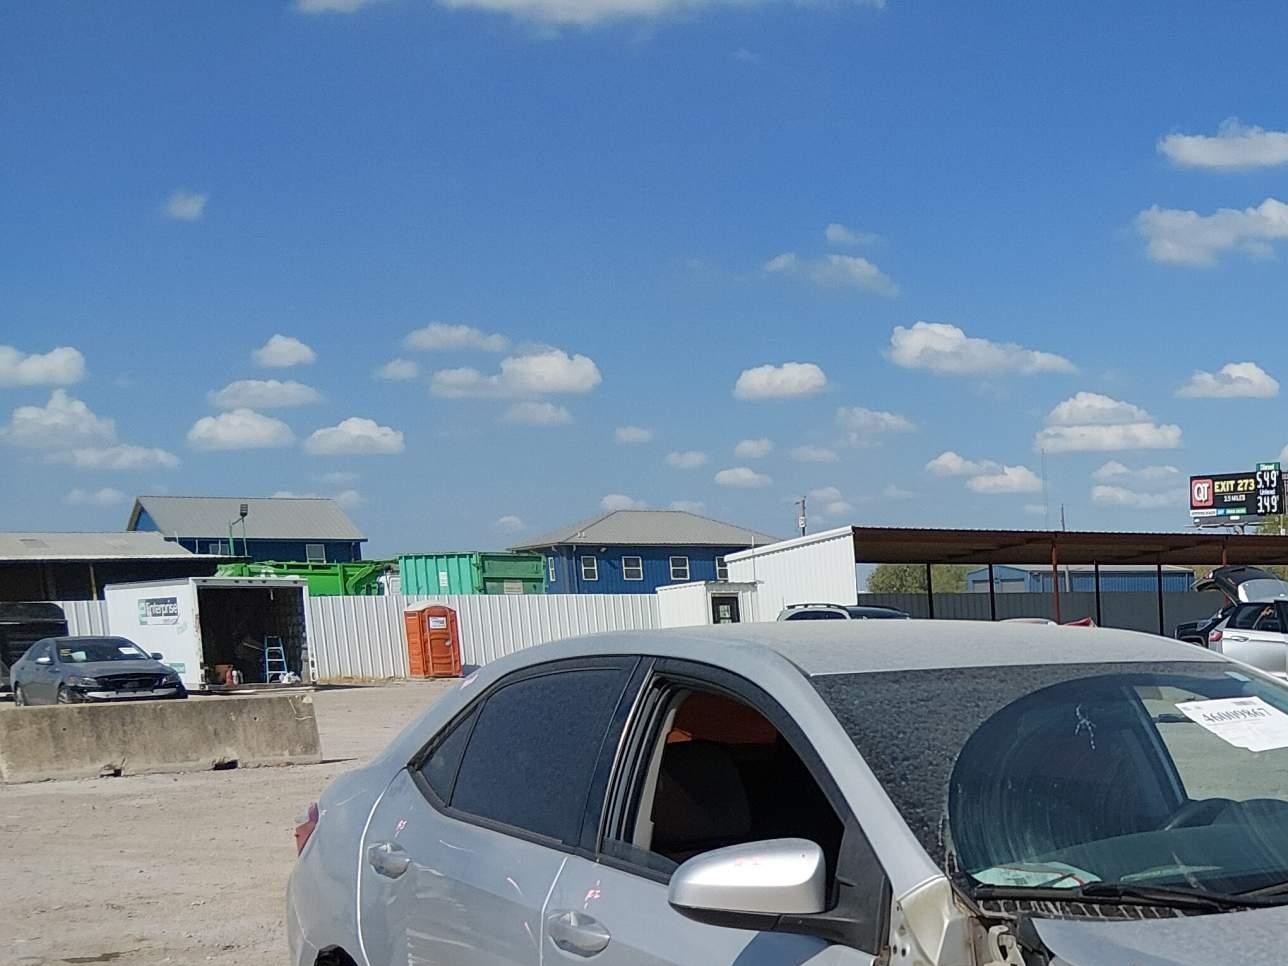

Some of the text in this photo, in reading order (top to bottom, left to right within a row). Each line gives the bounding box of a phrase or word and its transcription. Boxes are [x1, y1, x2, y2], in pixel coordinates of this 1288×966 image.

[1194, 483, 1209, 503] QT
[1214, 478, 1255, 493] EXIT 273
